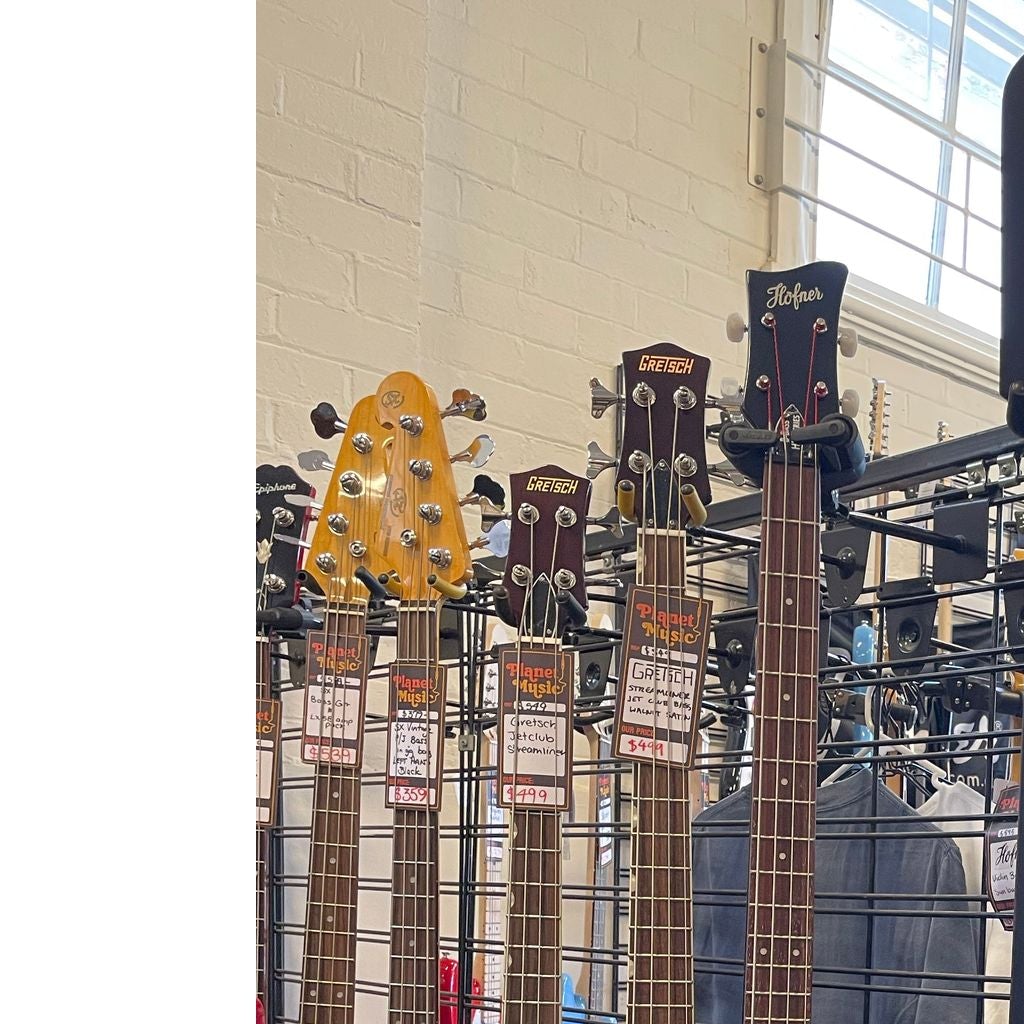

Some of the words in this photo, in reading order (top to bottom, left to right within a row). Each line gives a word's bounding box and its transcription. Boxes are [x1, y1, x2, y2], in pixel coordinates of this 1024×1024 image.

[638, 354, 695, 375] GRETSCH
[526, 475, 579, 495] GRETSCH
[506, 662, 557, 682] Plane
